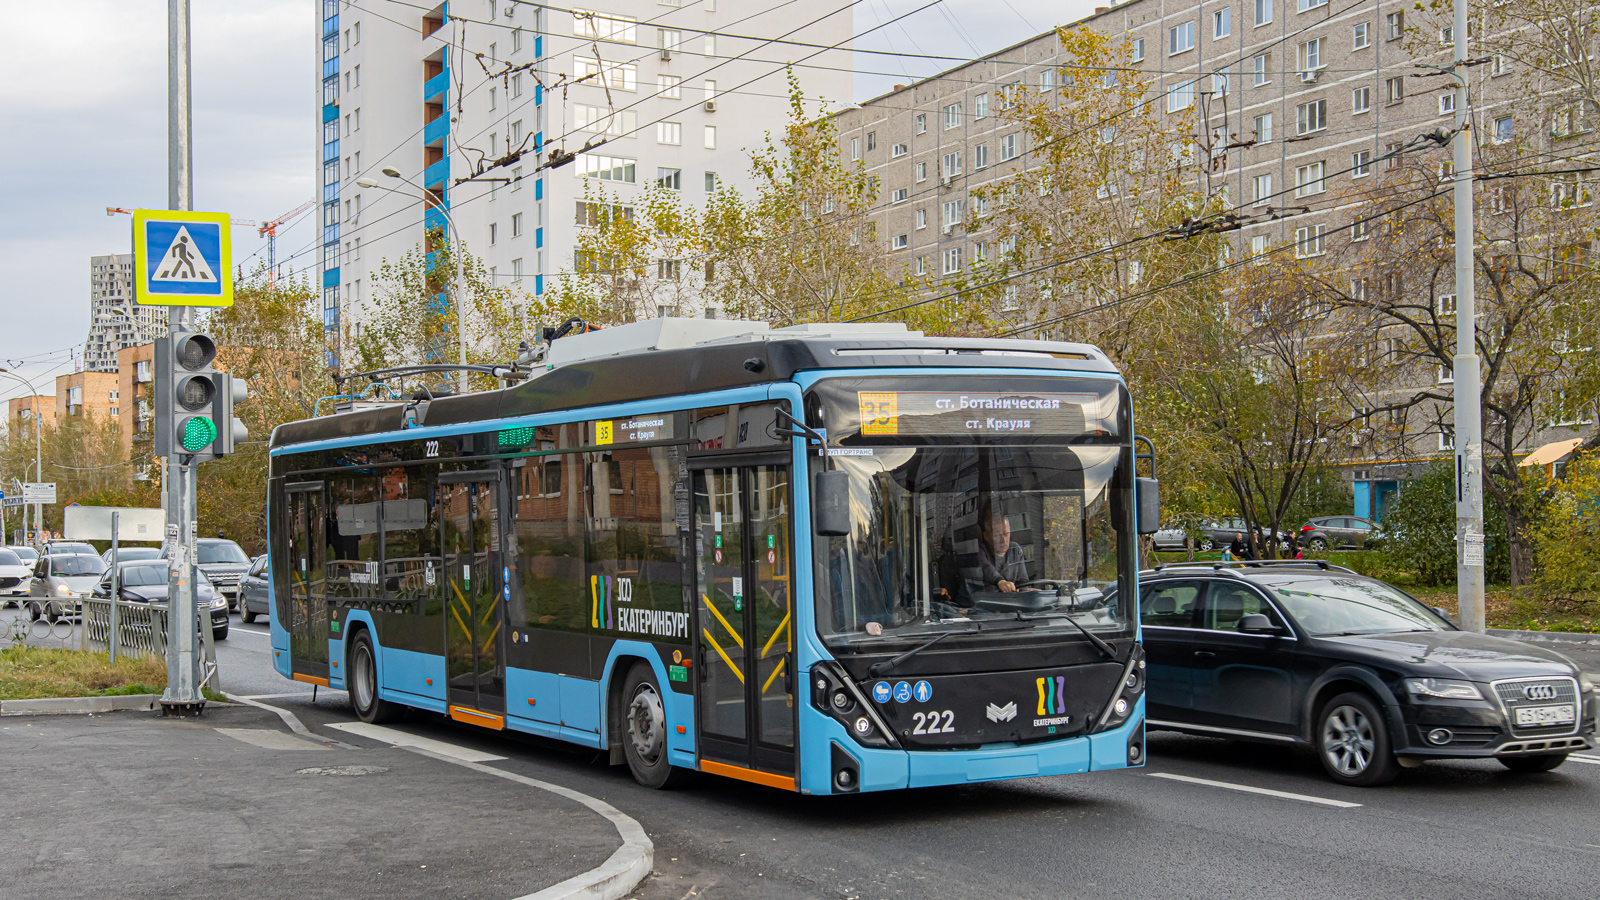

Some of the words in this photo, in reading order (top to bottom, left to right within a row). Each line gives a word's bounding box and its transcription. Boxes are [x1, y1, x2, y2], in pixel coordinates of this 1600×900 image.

[935, 398, 955, 409] ст.
[960, 395, 1060, 409] Ботаническая
[863, 401, 891, 426] 35
[621, 421, 629, 430] ст.
[629, 418, 664, 429] Ботаническая
[965, 419, 983, 429] ст.
[986, 417, 1031, 431] Крауля
[600, 426, 609, 440] 35
[629, 432, 637, 440] ст.
[637, 430, 655, 440] Крауля
[426, 440, 439, 457] 222
[617, 607, 690, 639] ЕКАТЕРИНБУРГ
[912, 709, 955, 736] 222
[1033, 716, 1070, 727] ЕКАТЕРИНБУРГ
